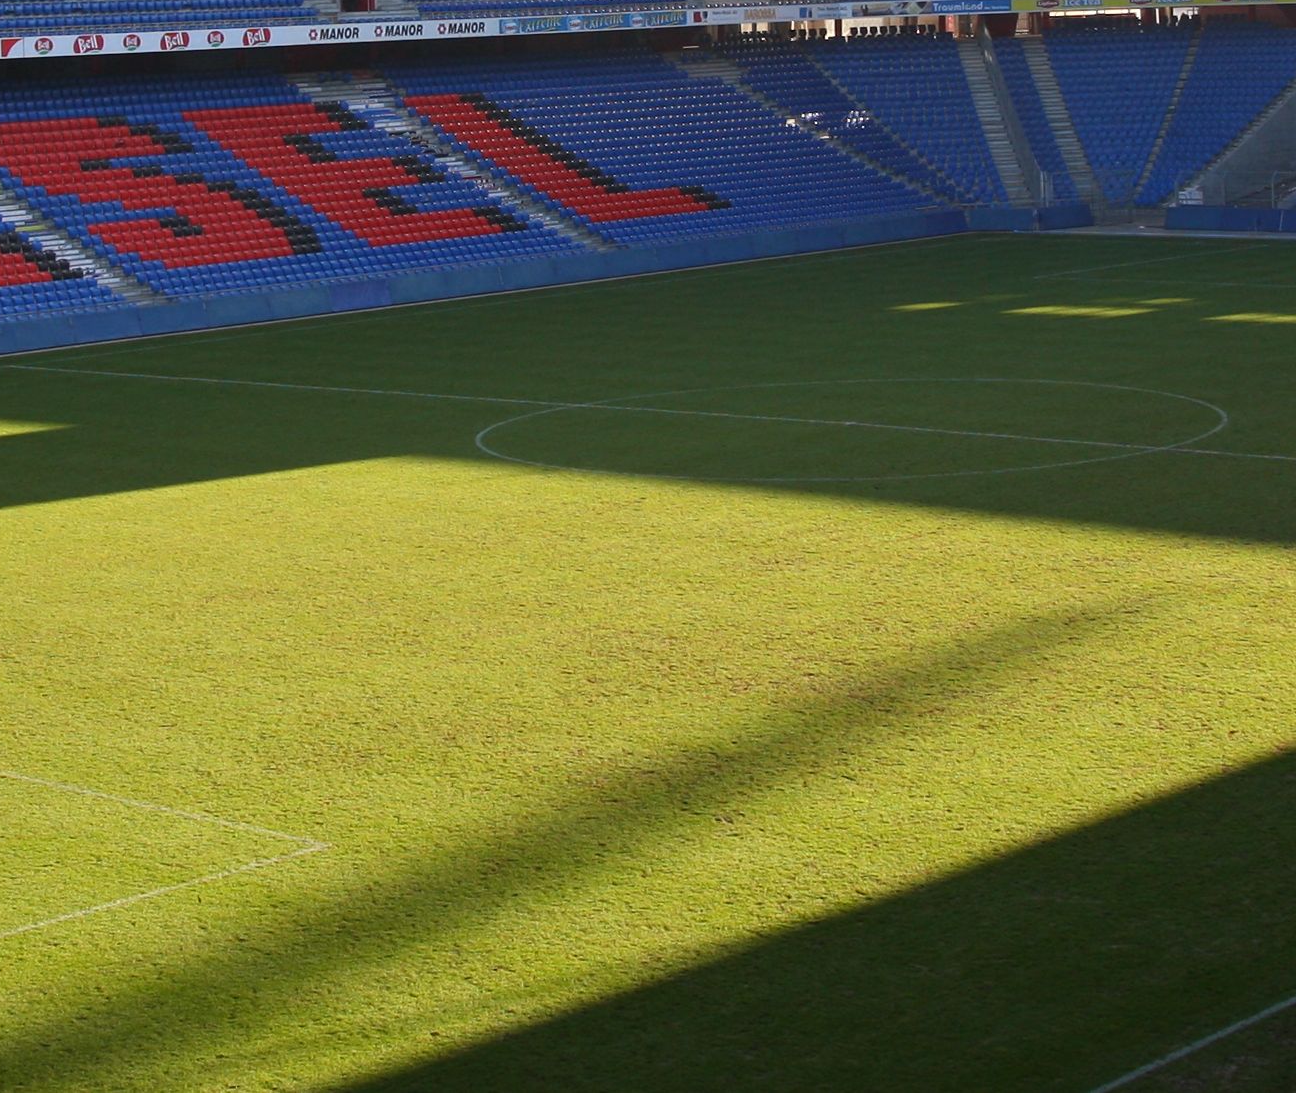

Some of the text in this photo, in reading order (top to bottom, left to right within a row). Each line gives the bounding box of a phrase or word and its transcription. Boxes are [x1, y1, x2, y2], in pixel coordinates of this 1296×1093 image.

[78, 35, 98, 54] Bell
[164, 33, 184, 51] Bell
[246, 29, 265, 47] Bell
[320, 22, 485, 40] MANOR MANOR MANOR
